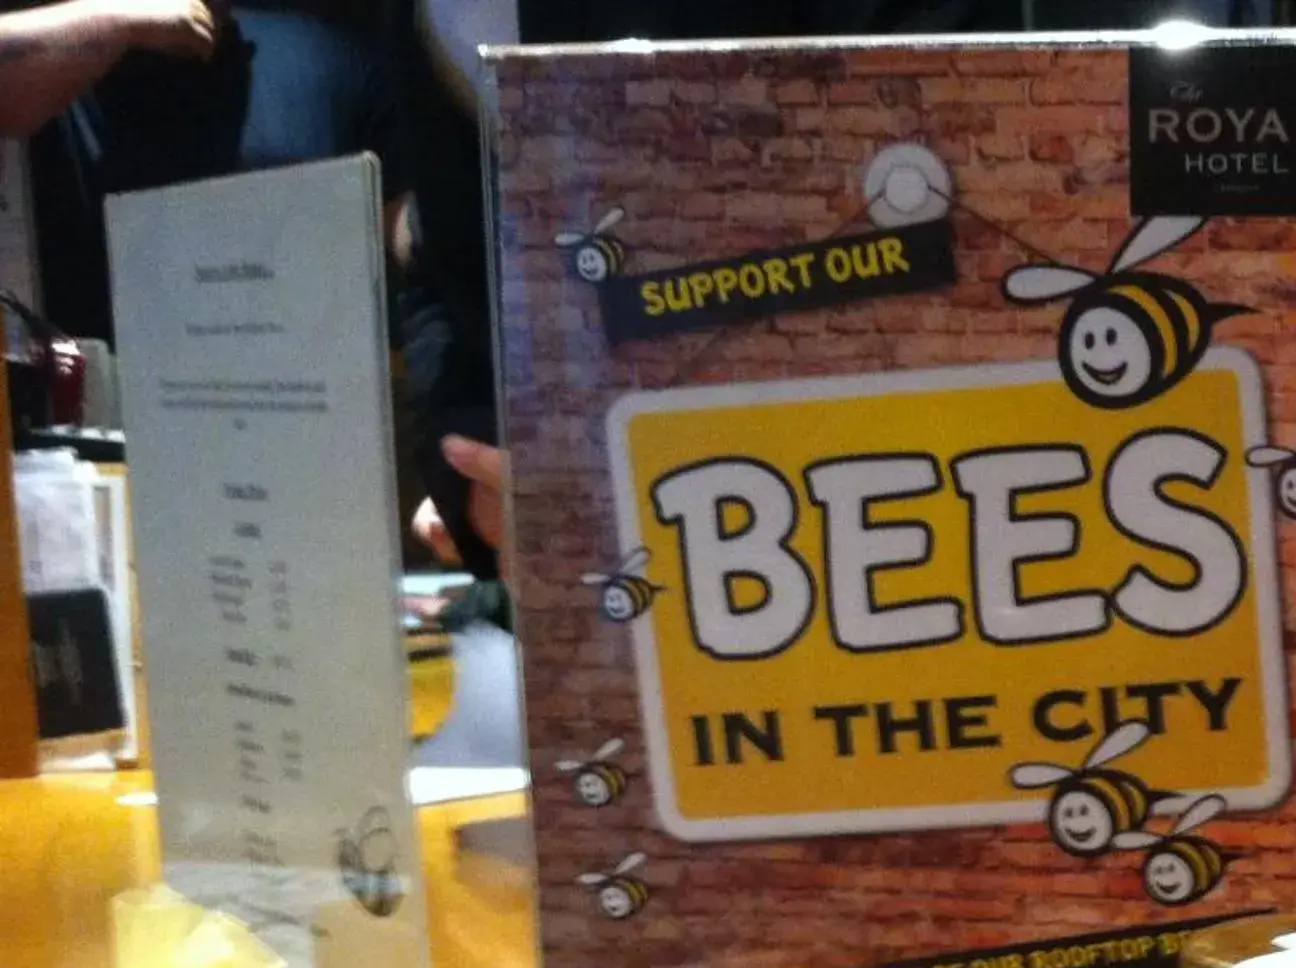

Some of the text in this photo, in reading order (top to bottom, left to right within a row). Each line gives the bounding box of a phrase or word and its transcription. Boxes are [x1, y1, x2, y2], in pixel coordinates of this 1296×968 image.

[1184, 152, 1290, 174] HOTEL
[640, 237, 911, 316] SUPPORT OUR
[650, 426, 1248, 661] BEES
[689, 677, 1243, 766] IN THE CITY
